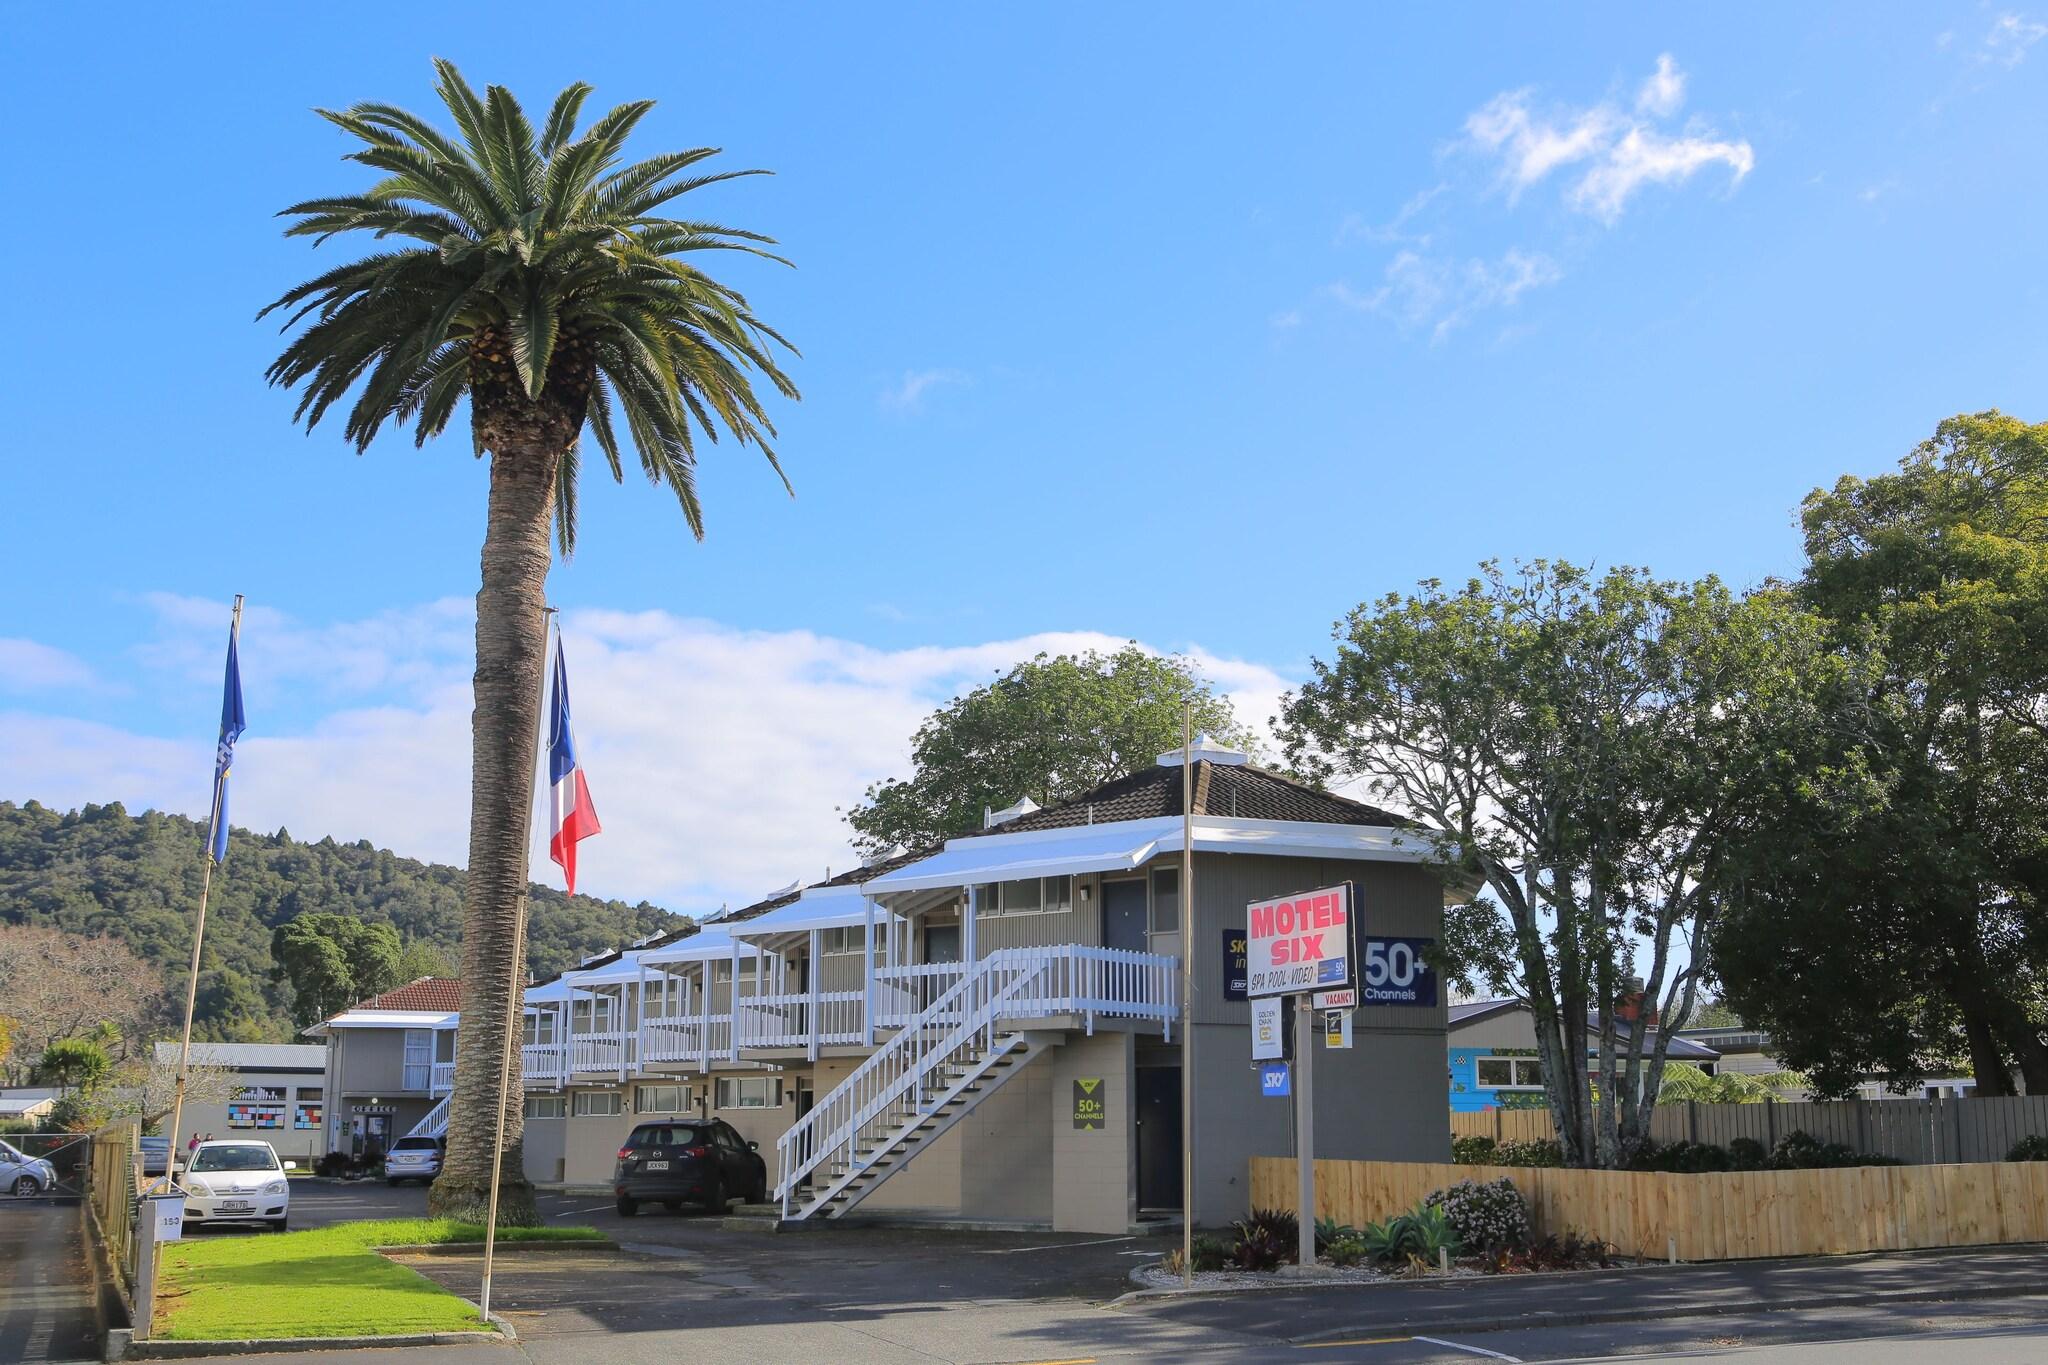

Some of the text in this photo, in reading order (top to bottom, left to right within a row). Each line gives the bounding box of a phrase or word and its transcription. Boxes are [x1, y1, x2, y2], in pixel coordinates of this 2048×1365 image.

[1251, 893, 1346, 939] MOTEL
[1230, 940, 1247, 953] SK
[1271, 934, 1324, 966] SIX
[1365, 942, 1429, 987] 50+
[1251, 973, 1265, 991] SPA
[1267, 969, 1287, 988] POOL
[1291, 966, 1314, 985] VIDEO
[1325, 992, 1353, 1006] VACANCY
[1364, 987, 1416, 1000] Channels
[1264, 1072, 1286, 1088] SKY
[1079, 1099, 1101, 1112] 50+
[1074, 1112, 1103, 1120] CHANNELS
